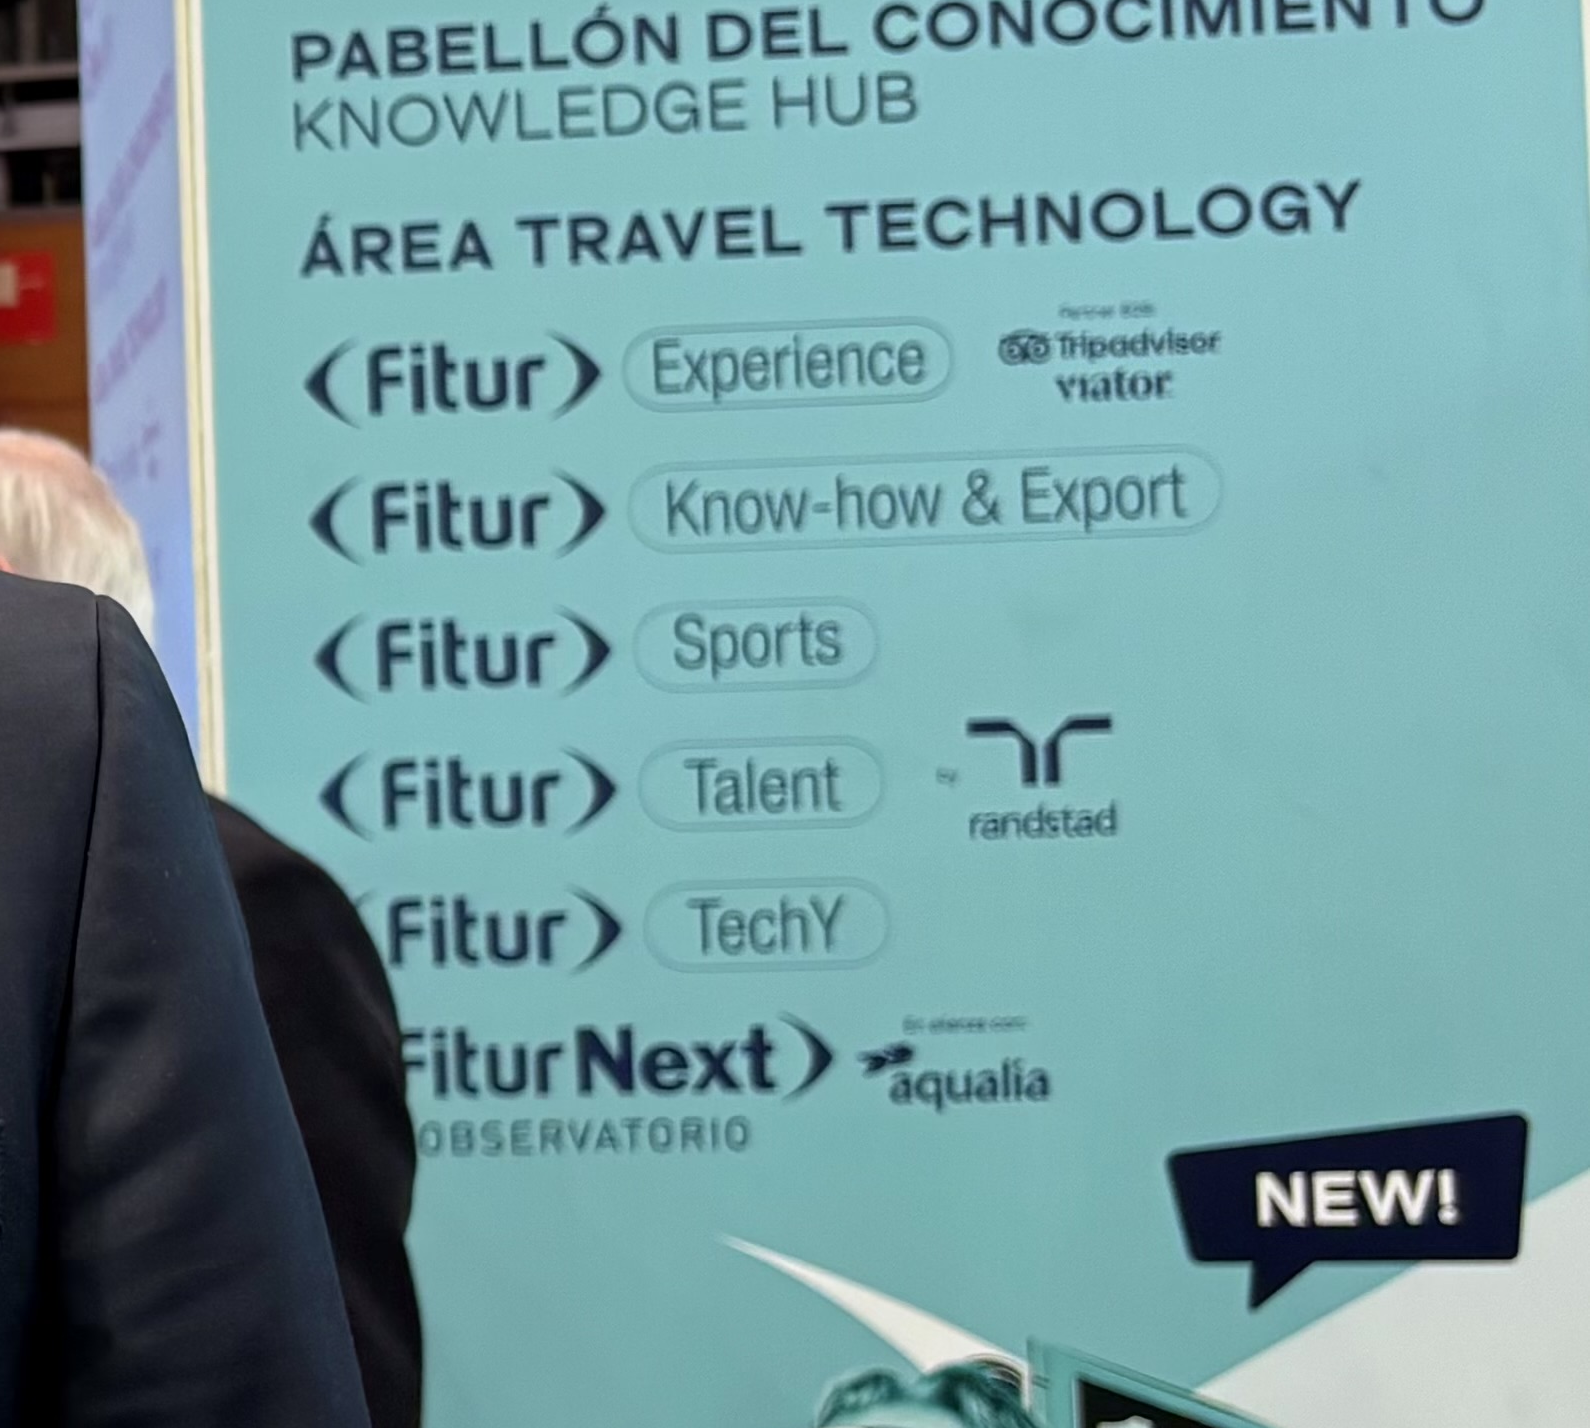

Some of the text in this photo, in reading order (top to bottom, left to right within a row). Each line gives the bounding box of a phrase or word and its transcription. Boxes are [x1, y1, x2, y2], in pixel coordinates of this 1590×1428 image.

[290, 2, 682, 82] PABELLÓN
[706, 6, 850, 63] DEL
[291, 70, 921, 152] KNOWLEDGE HUB
[300, 179, 1362, 280] ÁREA TRAVEL TECHNOLOGY
[366, 327, 1221, 417] Fitur Experience Tripadvisor
[1055, 367, 1174, 402] viator
[371, 463, 1187, 556] Fitur Know-how & Export
[376, 609, 842, 693] Fitur Sports
[381, 756, 562, 831] Fitur
[684, 757, 842, 819] Talent
[969, 798, 1118, 841] randstad
[387, 894, 845, 968] Fitur TechY
[888, 1056, 1051, 1115] aqualia
[419, 1115, 752, 1159] OBSERVATORIO
[1254, 1168, 1459, 1229] NEW!
